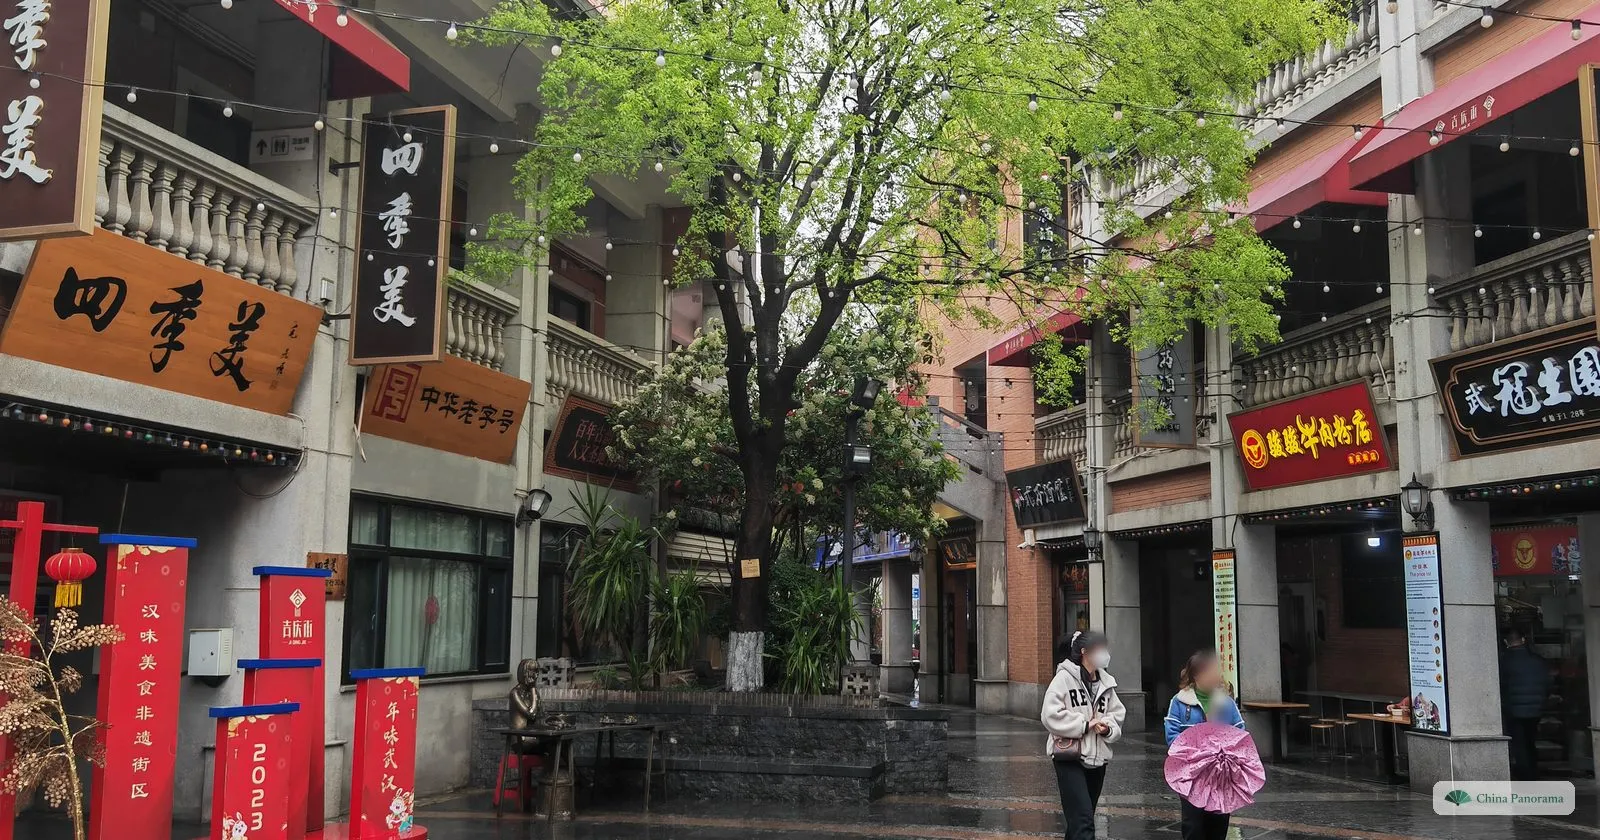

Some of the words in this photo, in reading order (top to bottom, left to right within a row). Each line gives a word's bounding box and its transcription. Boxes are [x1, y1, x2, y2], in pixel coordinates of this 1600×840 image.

[0, 0, 53, 185] 季美
[373, 141, 424, 328] 四季美
[53, 266, 266, 392] 四季美
[420, 386, 514, 434] 中华老字号
[282, 620, 313, 638] 吉庆街
[131, 604, 160, 799] 汉味美食非遗街区
[381, 701, 400, 793] 年味武汉
[250, 743, 267, 831] 2023
